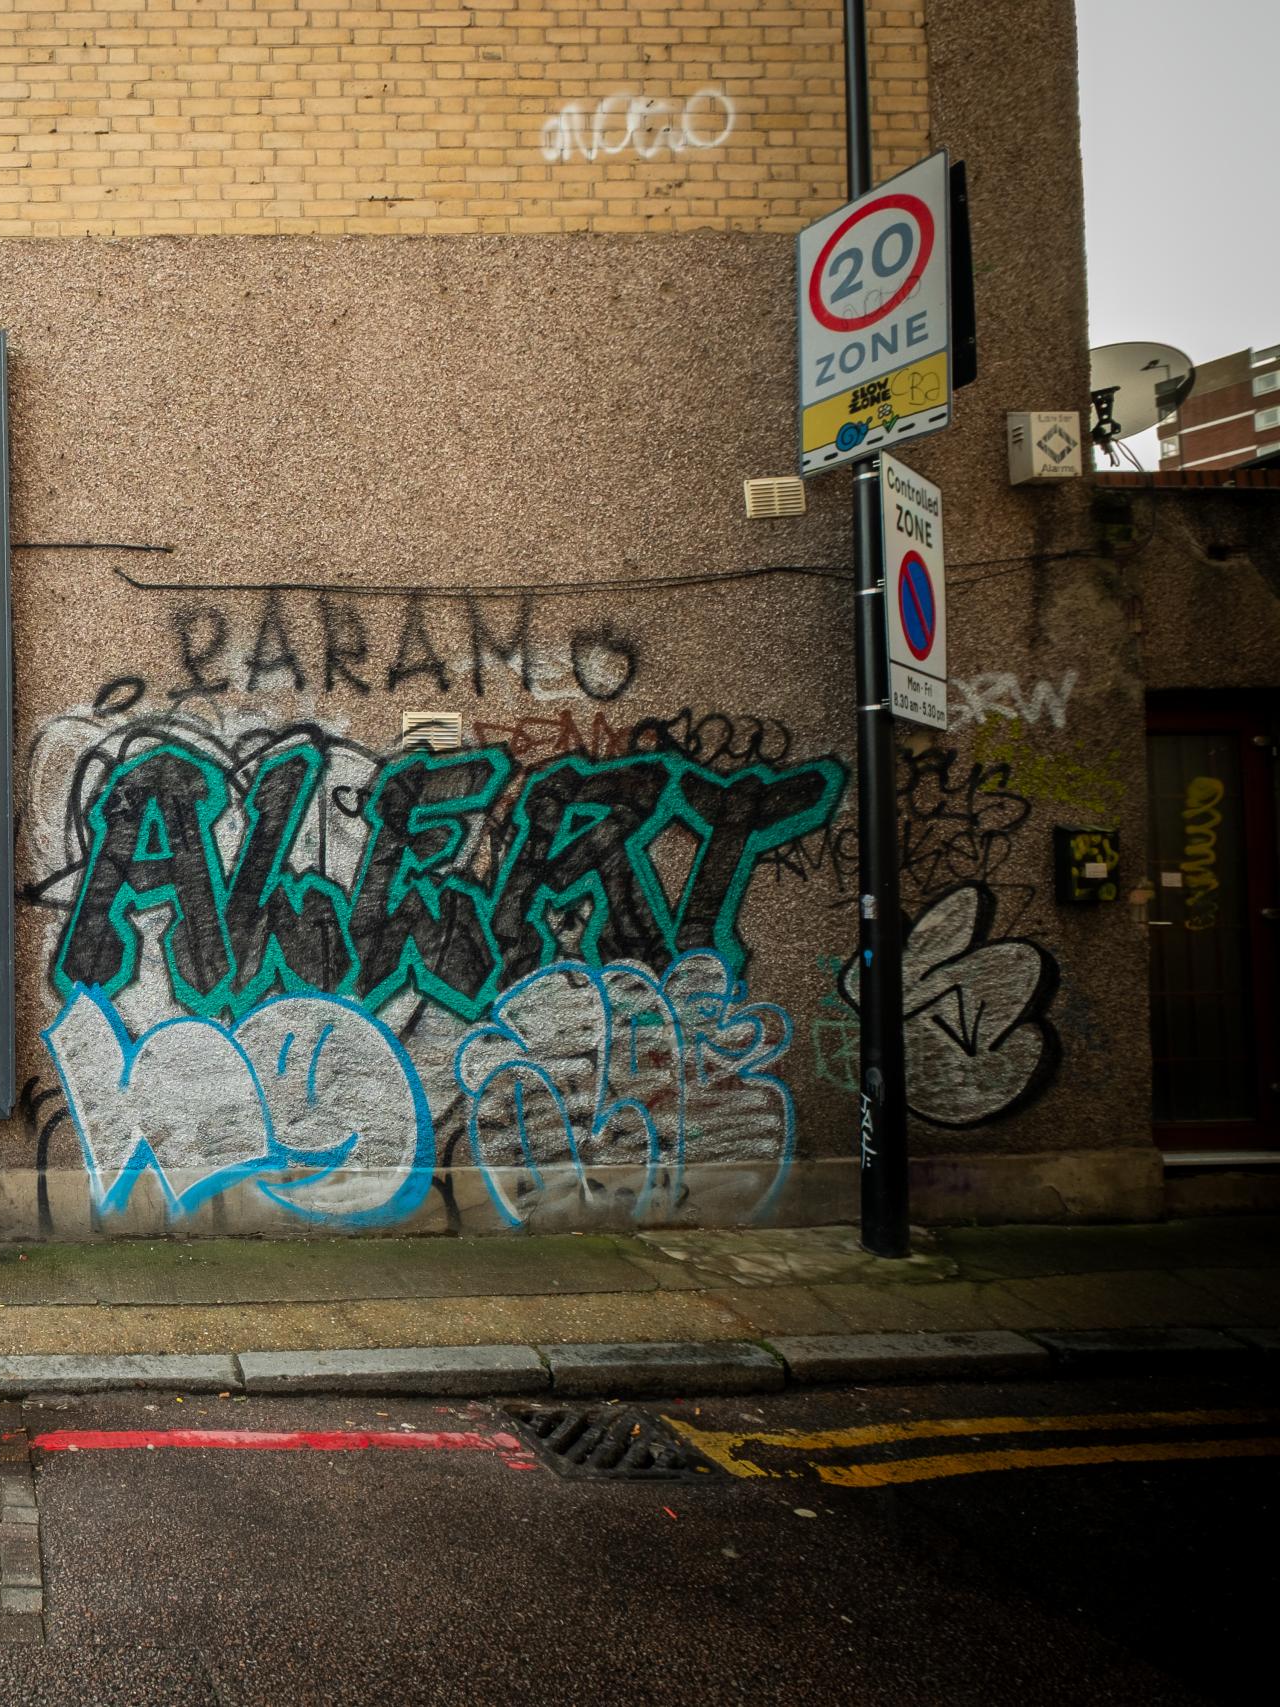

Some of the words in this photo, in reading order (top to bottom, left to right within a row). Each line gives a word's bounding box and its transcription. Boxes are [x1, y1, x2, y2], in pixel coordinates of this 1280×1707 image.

[828, 222, 914, 305] 20
[815, 310, 929, 388] ZONE
[887, 466, 939, 517] Controlled
[896, 503, 933, 549] ZONE
